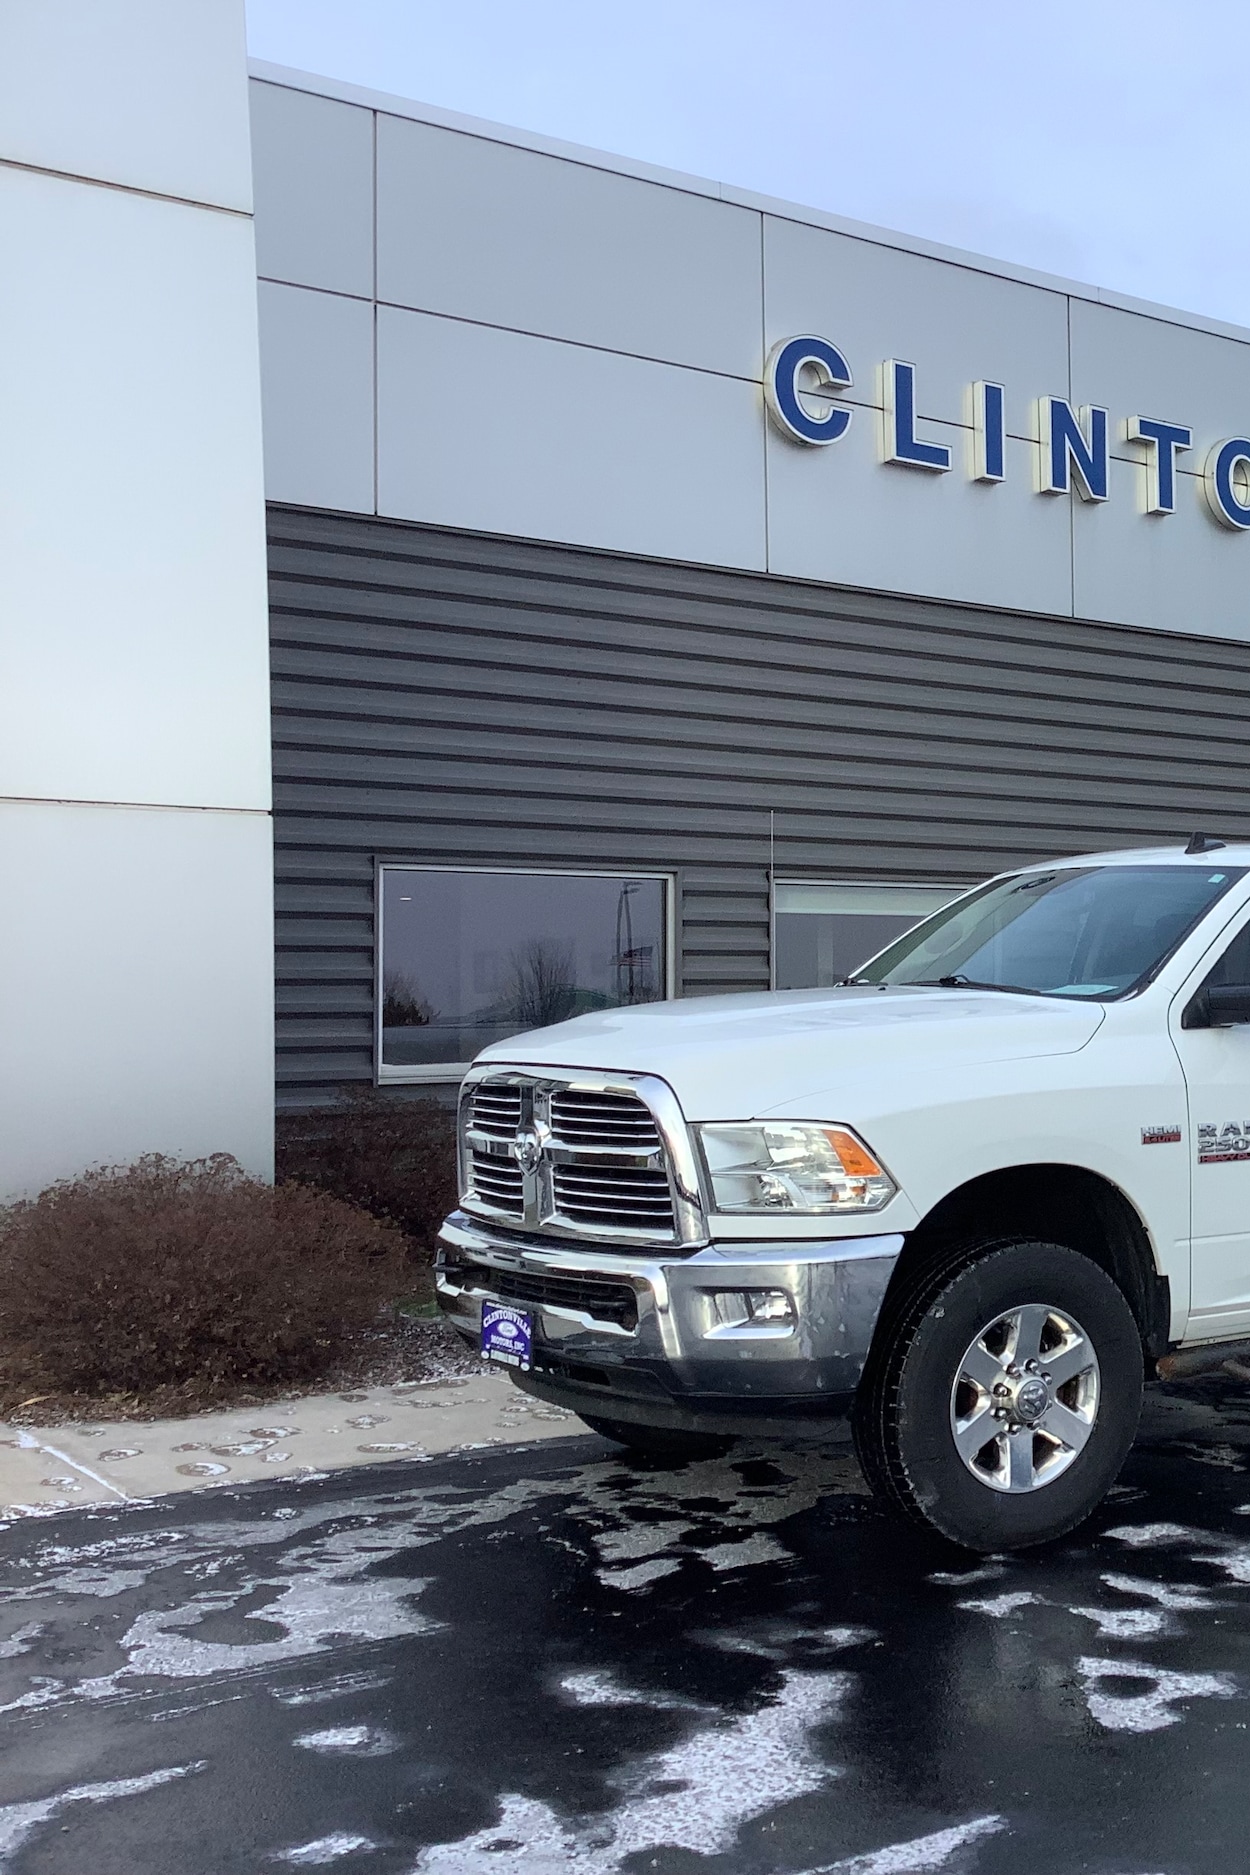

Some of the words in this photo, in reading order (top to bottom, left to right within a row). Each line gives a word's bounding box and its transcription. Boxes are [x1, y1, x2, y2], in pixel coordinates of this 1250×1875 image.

[1141, 1124, 1181, 1137] HEMI
[1202, 1154, 1236, 1163] HEAVY
[483, 1310, 531, 1339] CLINTONVILLE
